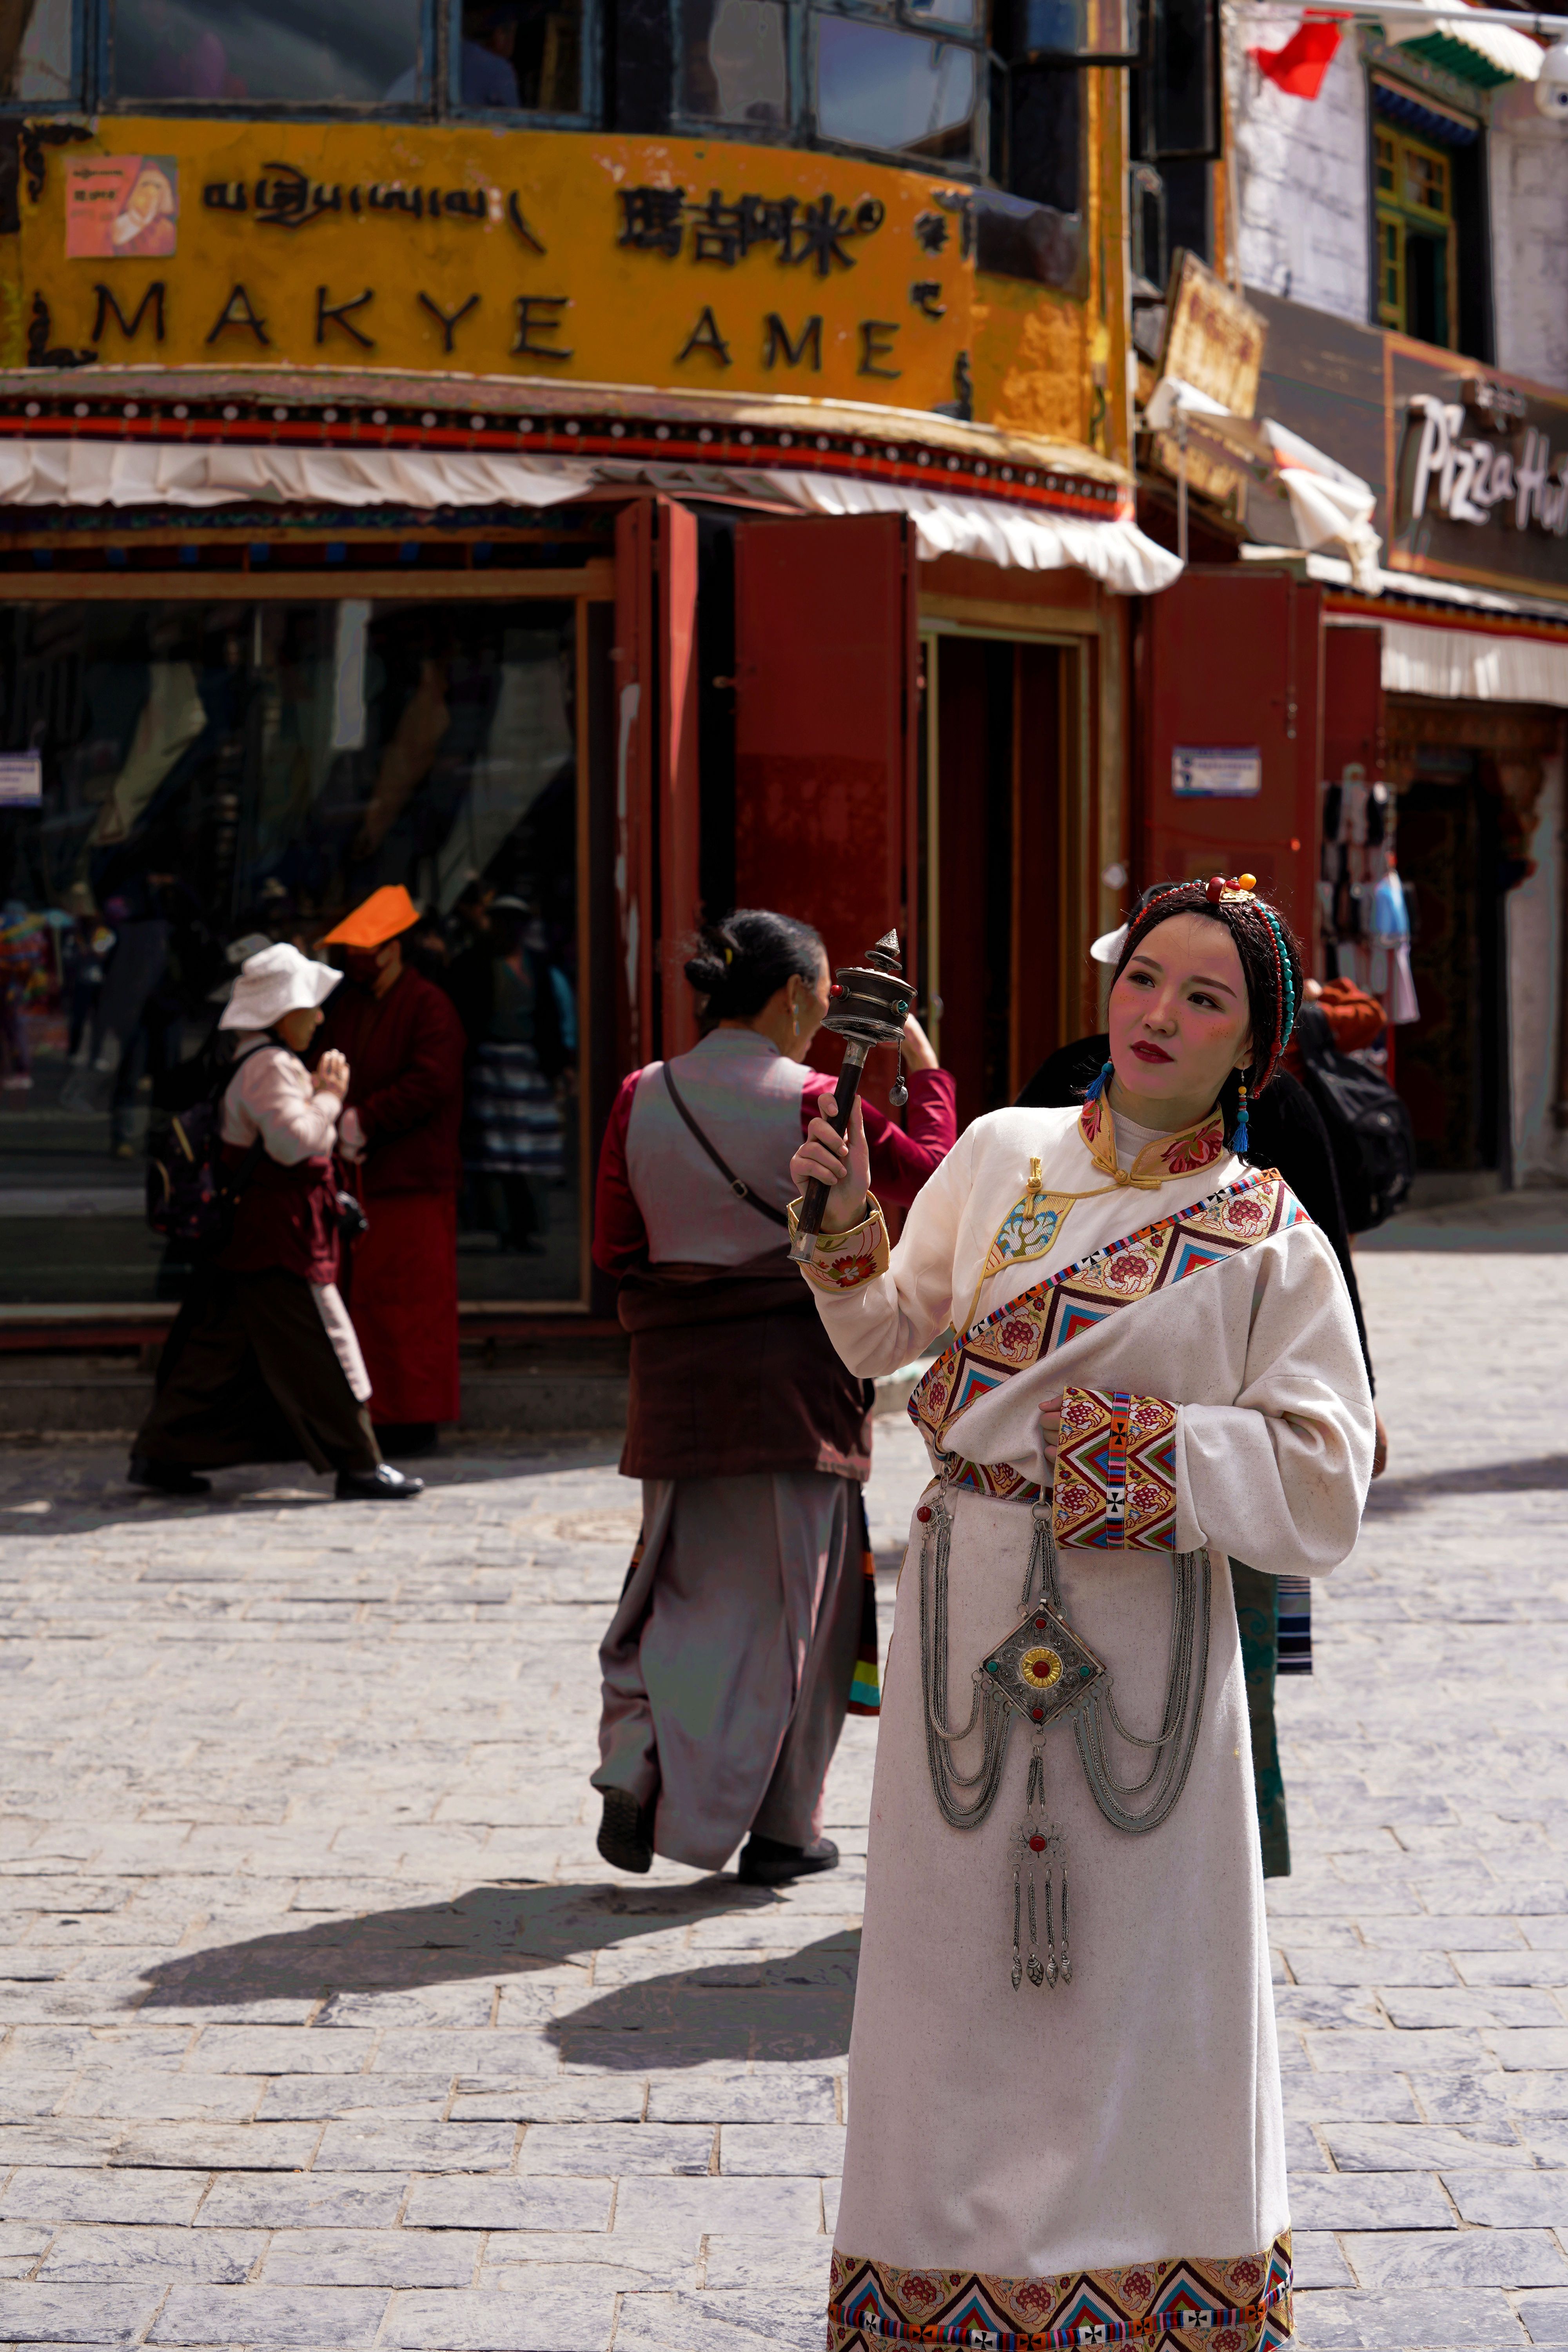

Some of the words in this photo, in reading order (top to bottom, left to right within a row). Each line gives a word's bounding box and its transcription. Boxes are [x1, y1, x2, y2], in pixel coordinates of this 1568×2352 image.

[90, 281, 574, 358] MAKYE
[674, 306, 902, 379] AME
[1409, 394, 1515, 525] Pizza
